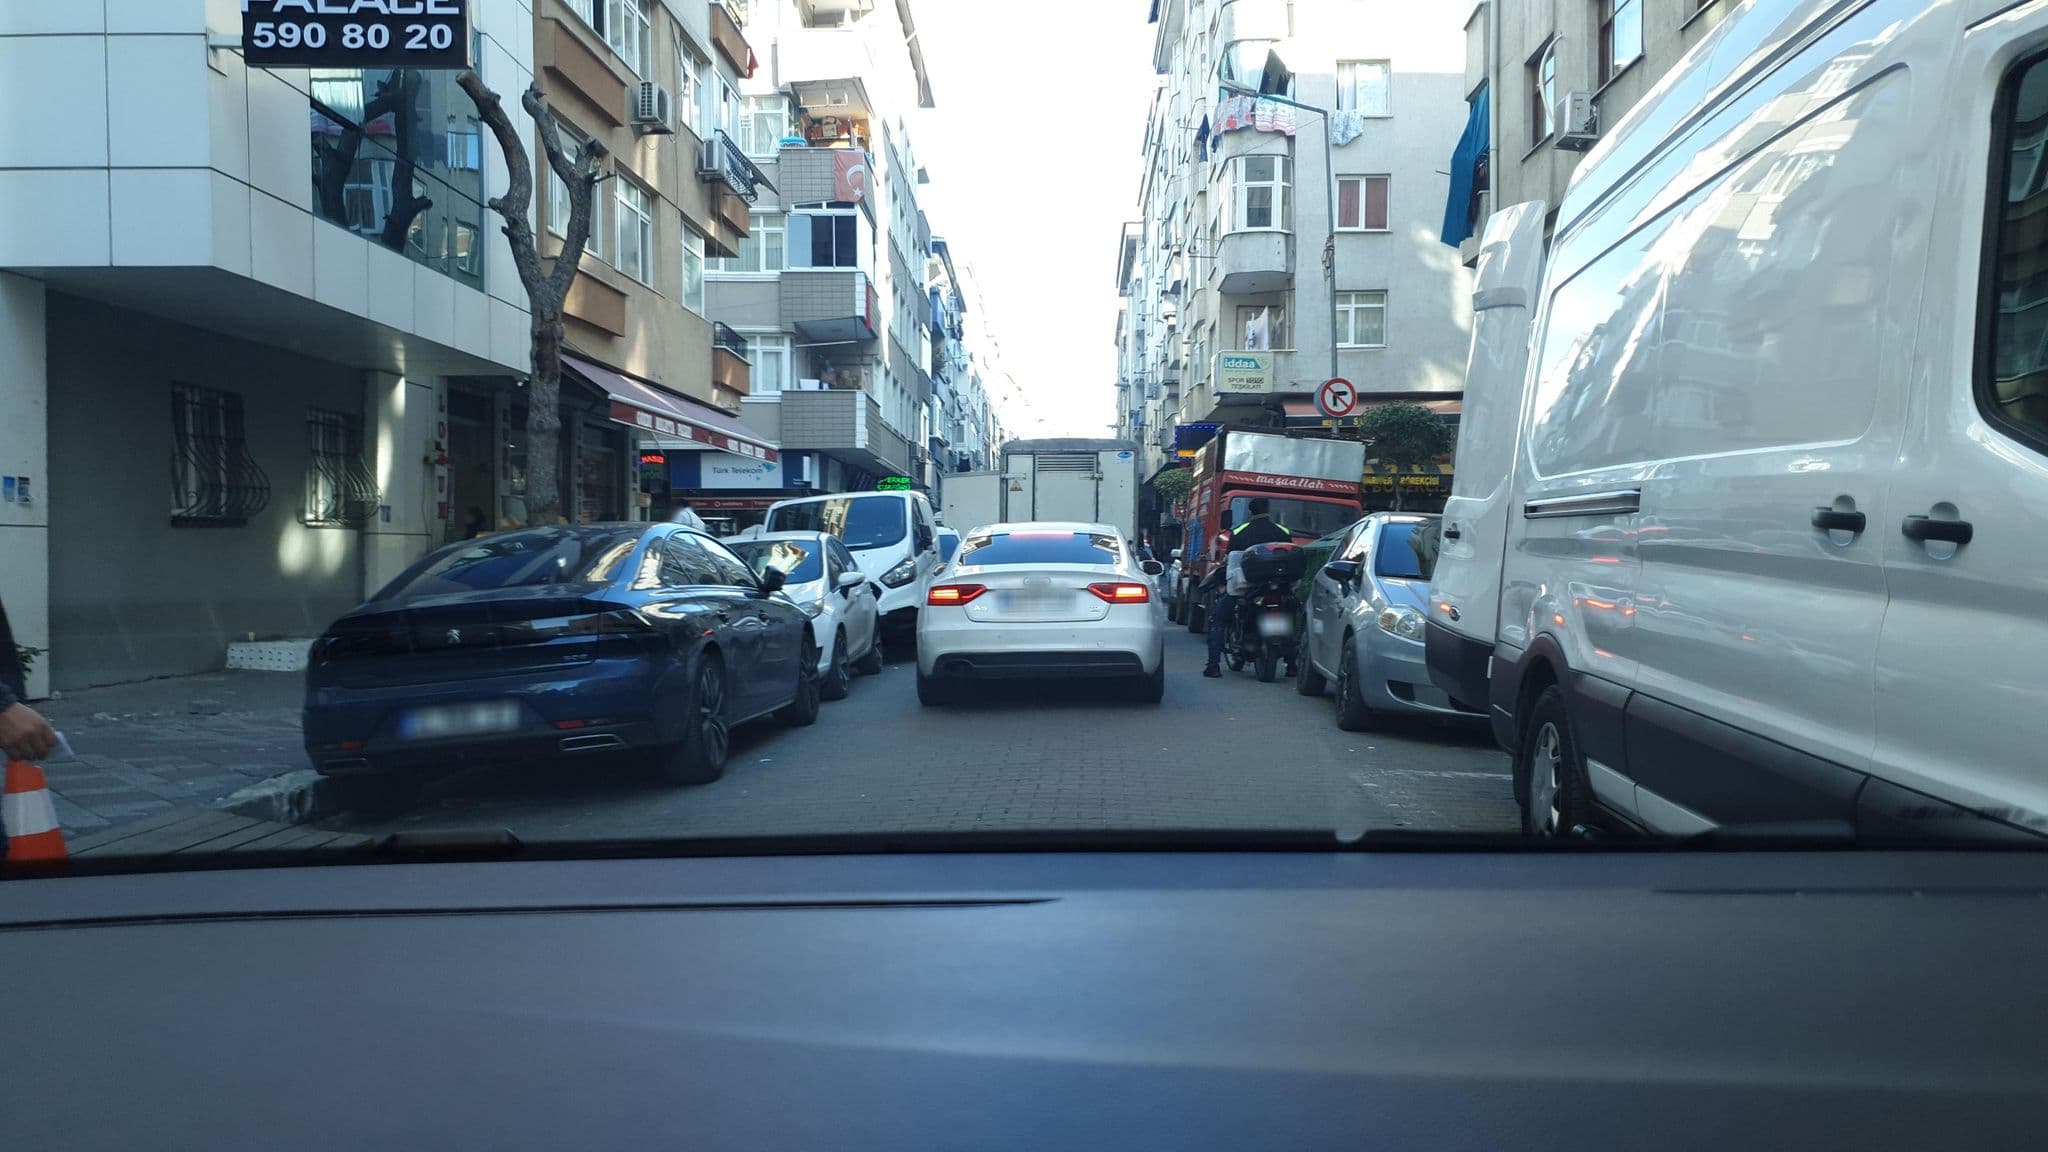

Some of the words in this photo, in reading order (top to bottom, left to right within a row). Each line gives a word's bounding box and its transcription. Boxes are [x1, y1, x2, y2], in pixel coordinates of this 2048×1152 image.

[252, 22, 327, 48] 590
[342, 24, 390, 49] 80
[404, 24, 453, 49] 20
[1224, 358, 1256, 368] iddaa
